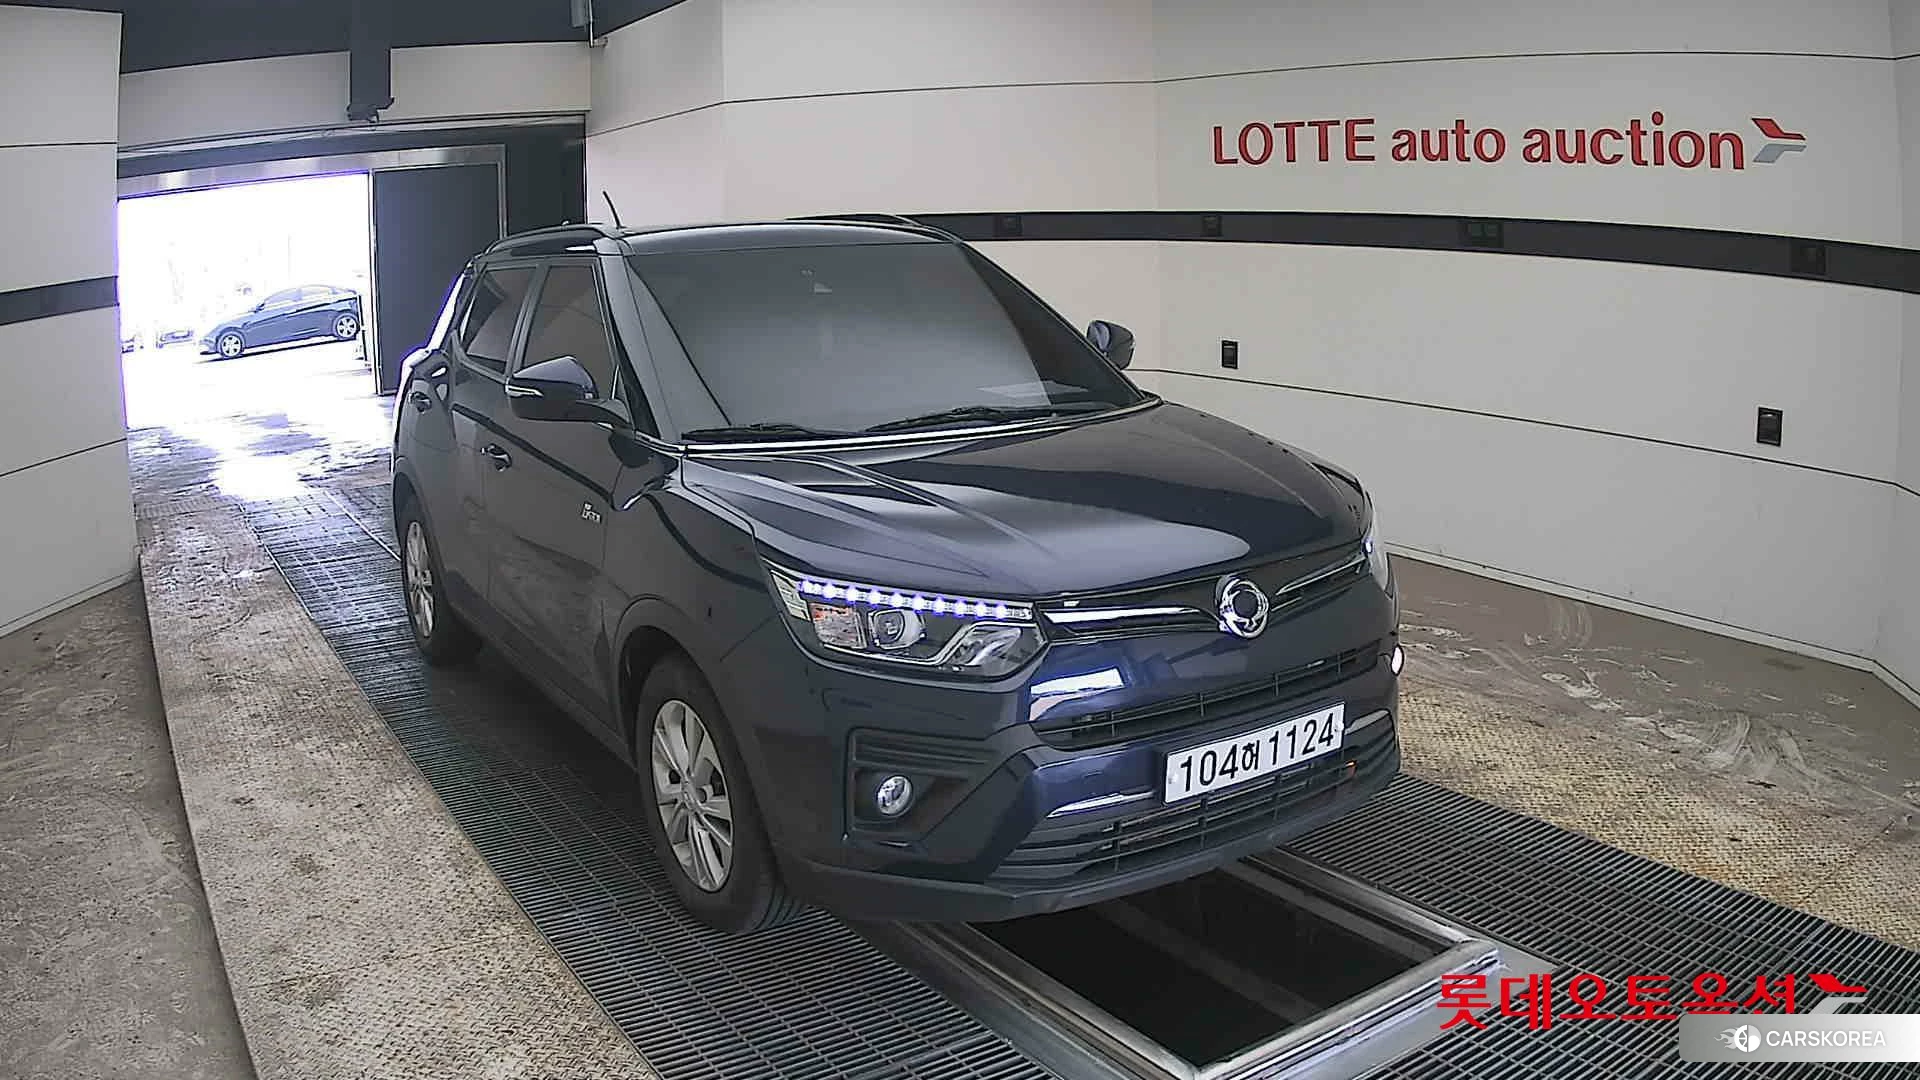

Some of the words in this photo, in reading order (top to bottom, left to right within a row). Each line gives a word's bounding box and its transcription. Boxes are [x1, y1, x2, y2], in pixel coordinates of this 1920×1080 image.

[1212, 118, 1376, 166] LOTTE
[1391, 119, 1507, 163] auto
[1522, 111, 1745, 171] auction
